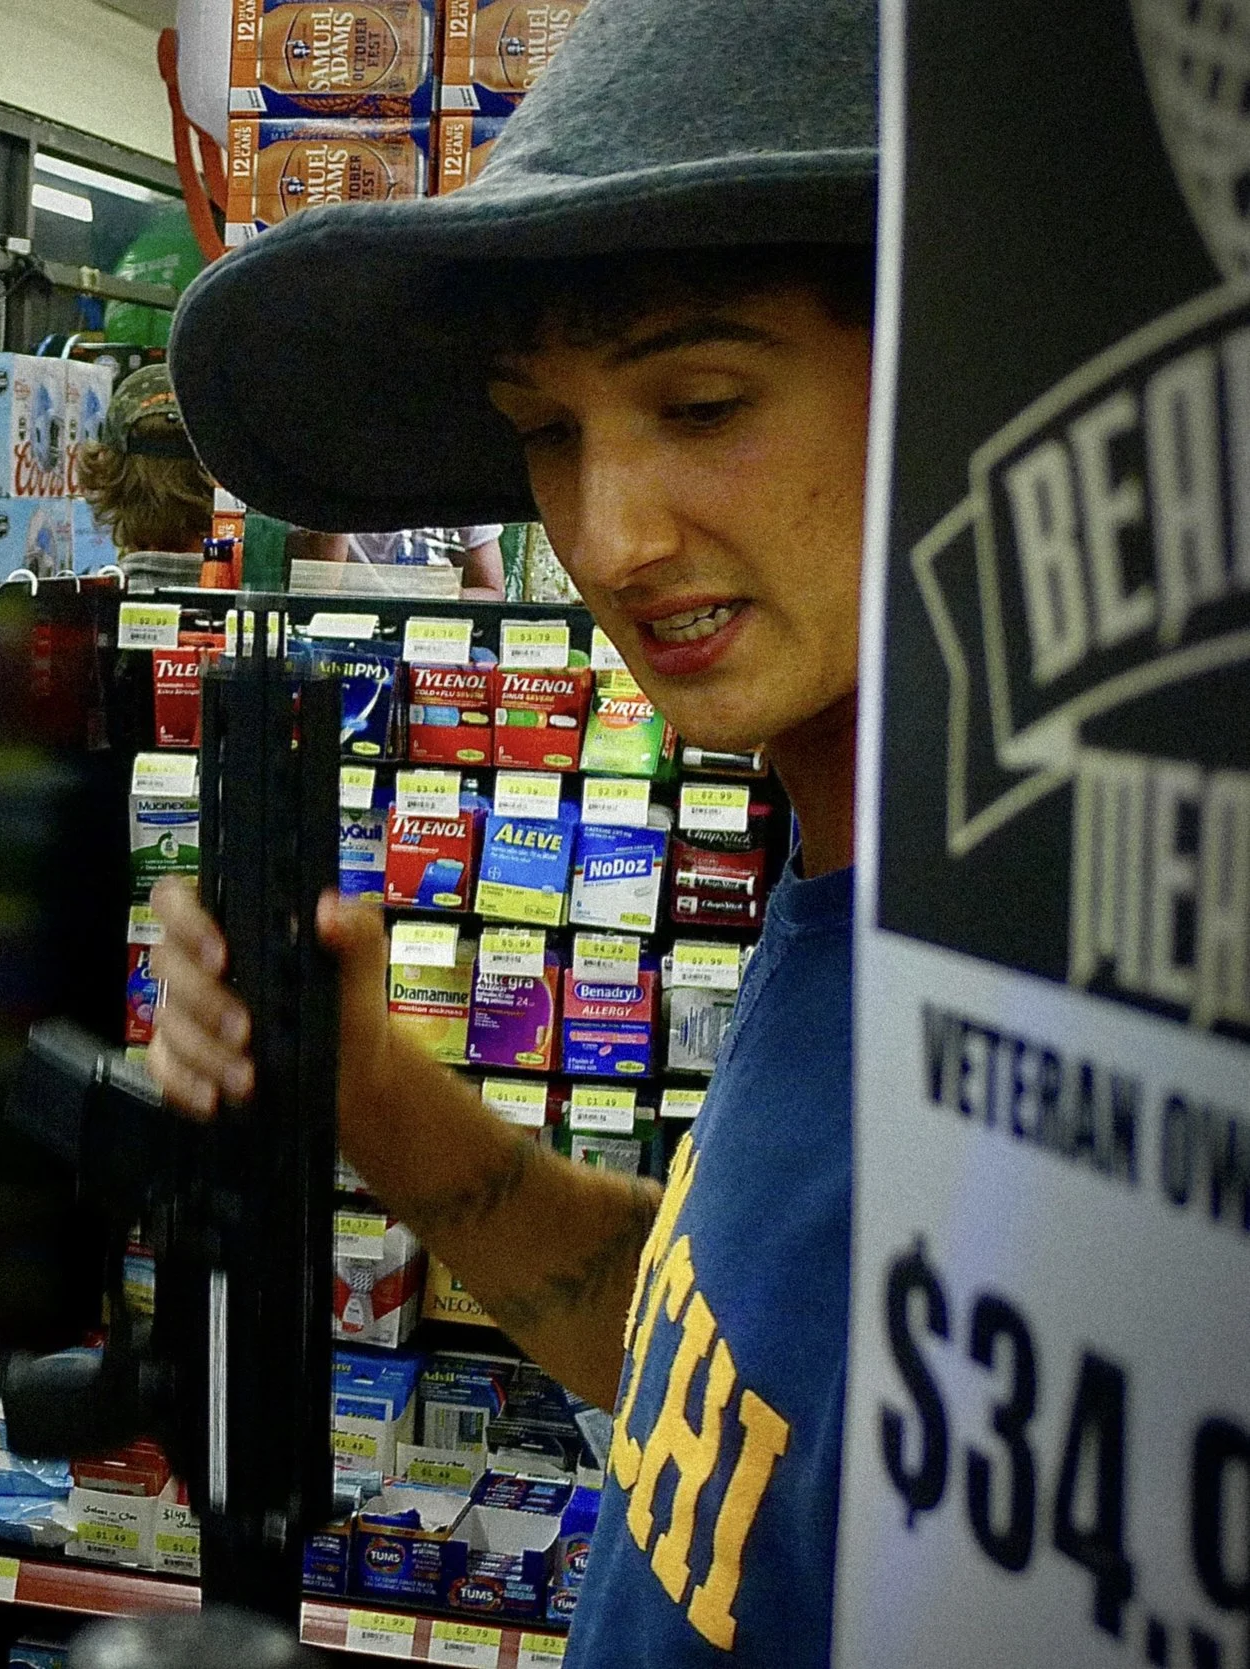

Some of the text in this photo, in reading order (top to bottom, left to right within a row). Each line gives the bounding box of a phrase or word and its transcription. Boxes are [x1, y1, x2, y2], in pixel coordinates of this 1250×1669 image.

[237, 22, 255, 42] 12
[449, 17, 469, 38] 12
[308, 7, 334, 93] SAMUEL
[329, 11, 355, 87] ADAMS
[353, 18, 368, 81] OCTOBER
[367, 31, 381, 68] FEST
[232, 125, 252, 178] 12 CANS
[444, 123, 465, 176] 12 CANS
[156, 659, 200, 679] TYLE
[414, 668, 487, 689] TYLENOL
[500, 673, 575, 694] TYLENOL
[502, 692, 525, 701] SINUS
[598, 697, 655, 718] ZYRTEC
[138, 801, 184, 811] Mucinex
[339, 823, 383, 842] yQuil
[391, 815, 467, 838] TYLENOL
[686, 828, 753, 845] ChapStick
[400, 833, 421, 844] PM
[493, 823, 563, 852] ALEVE
[589, 858, 647, 878] NoDoz
[476, 972, 535, 992] Allegra
[393, 983, 469, 1005] Dramamine
[580, 985, 637, 1001] Benadryl
[397, 1005, 428, 1014] motion
[581, 1005, 633, 1017] ALLERGY
[922, 1002, 1146, 1186] VETERAN
[434, 1294, 488, 1315] NEOS
[421, 1371, 455, 1383] Advil
[172, 1542, 199, 1554] $1.4
[370, 1549, 401, 1563] TUMS
[574, 1556, 590, 1568] TU
[460, 1587, 495, 1602] TUMS
[542, 1637, 562, 1648] $3.
